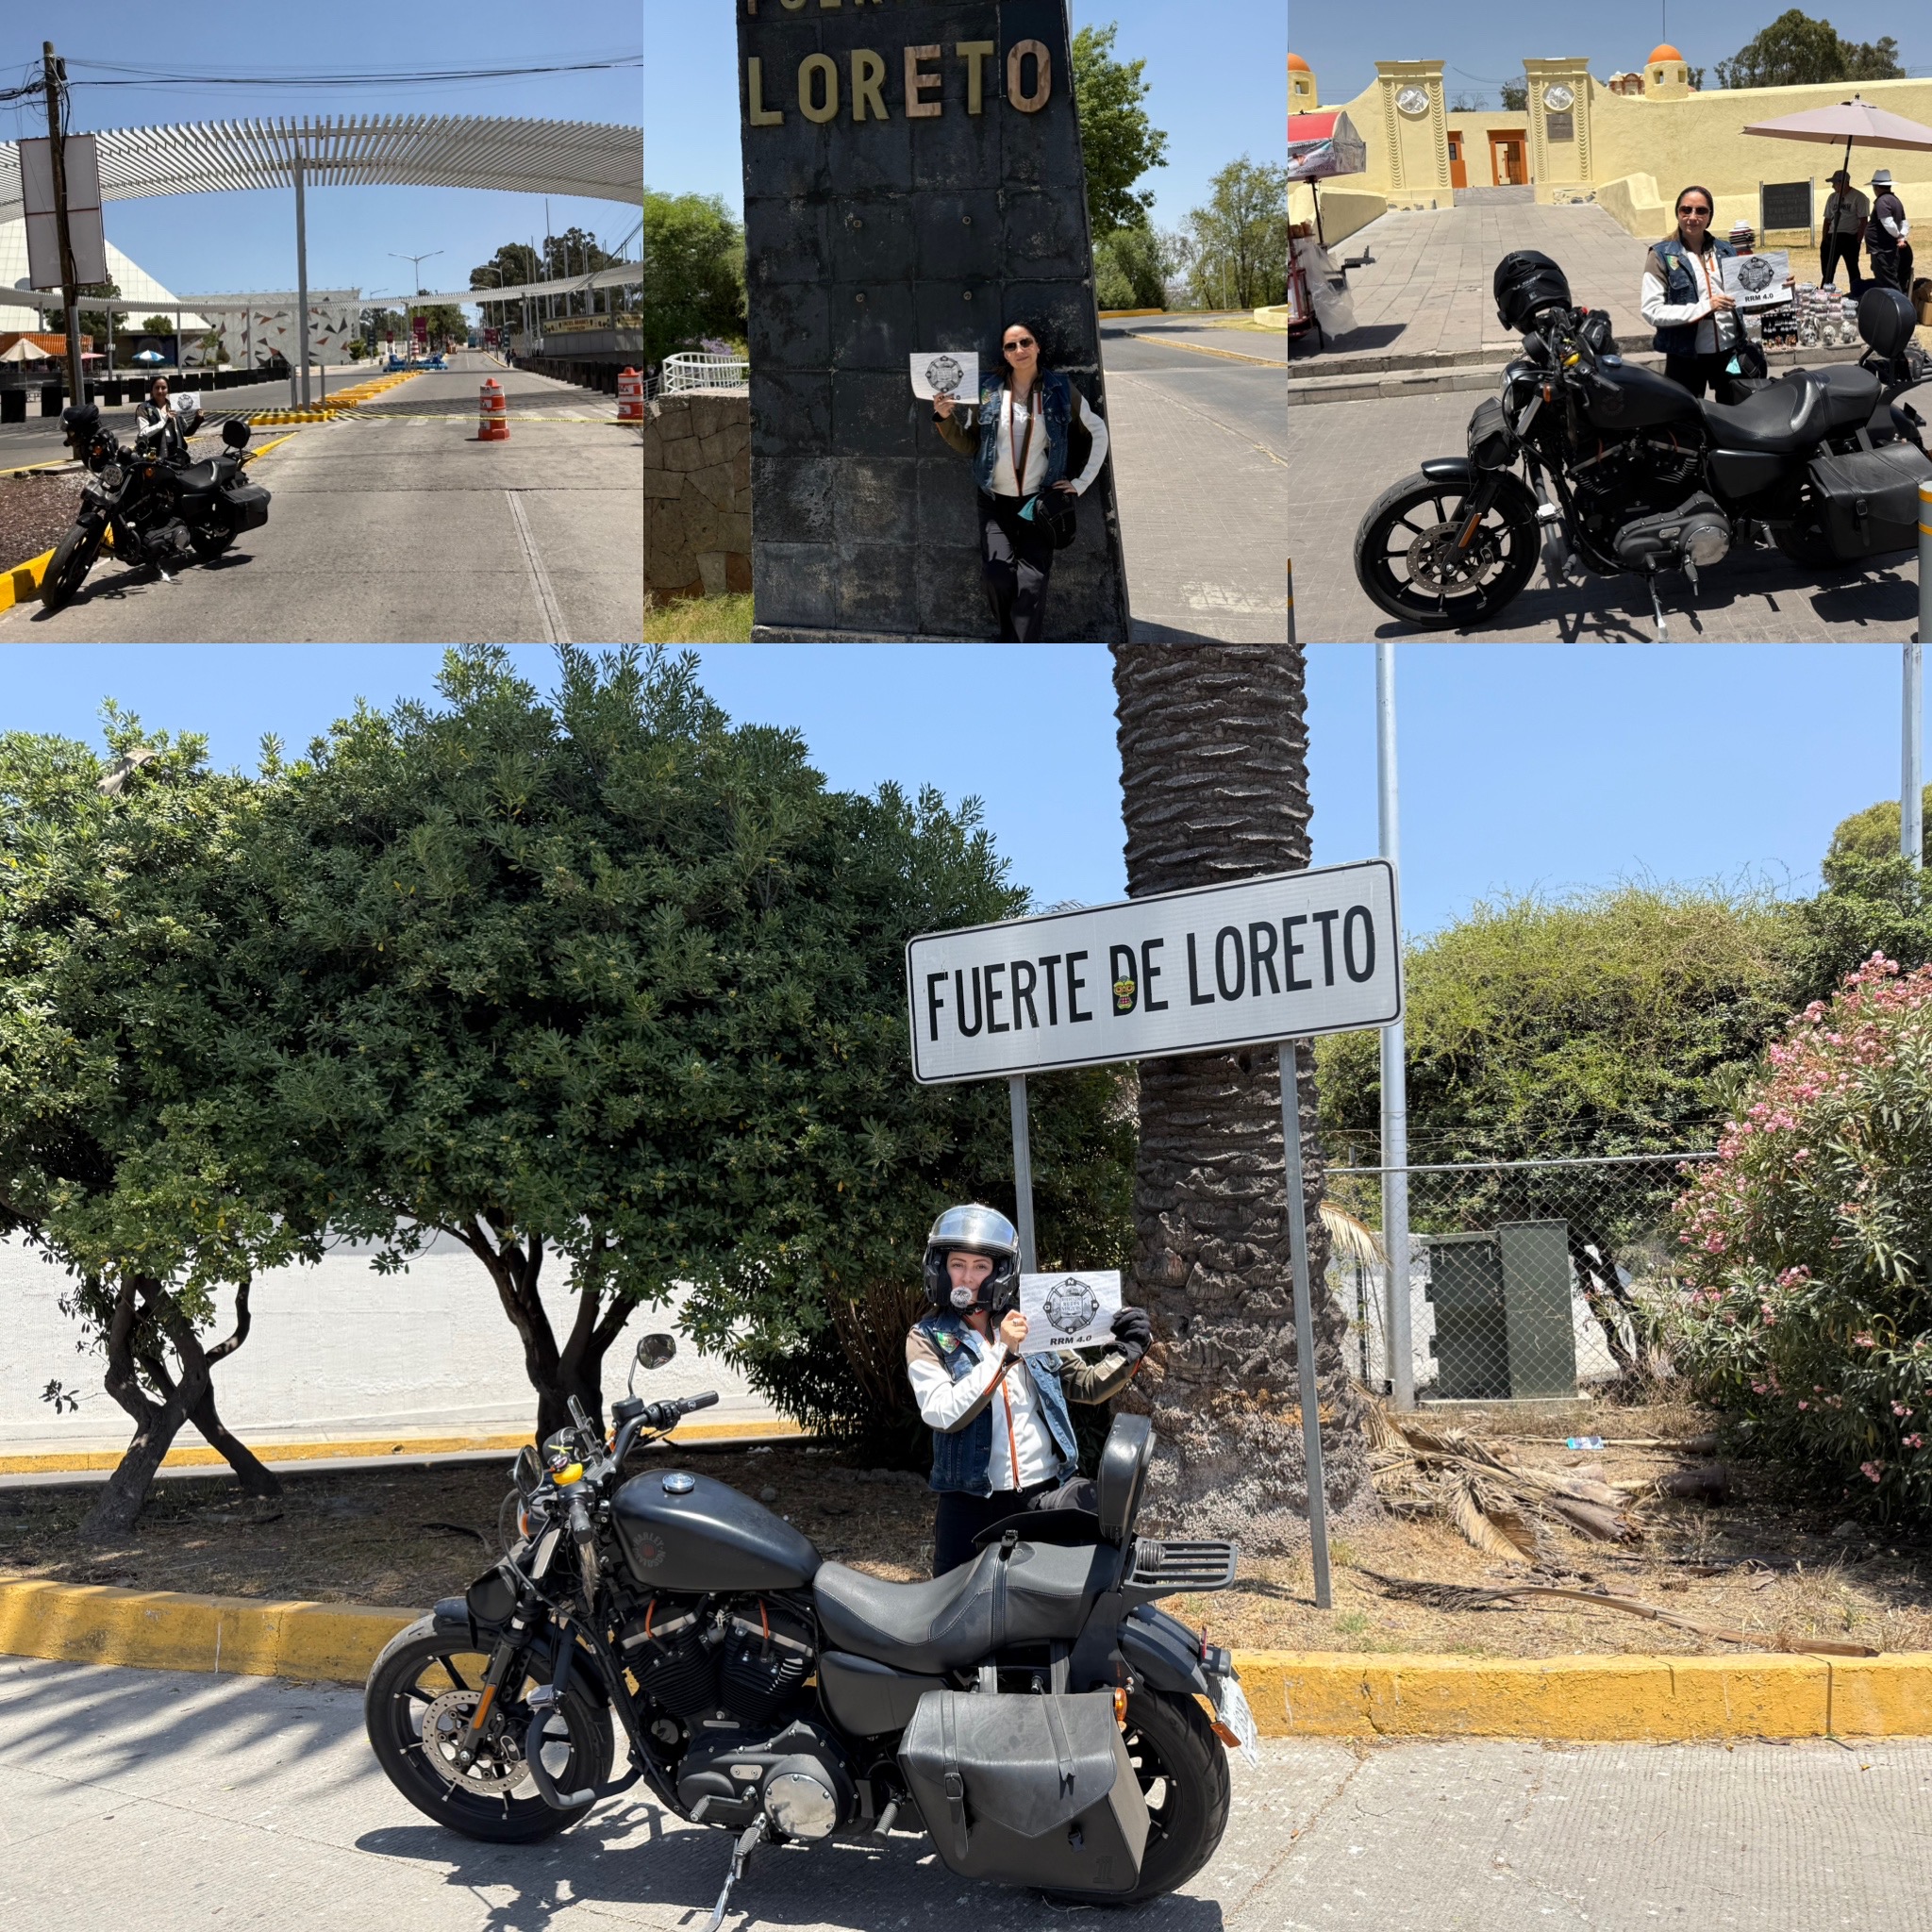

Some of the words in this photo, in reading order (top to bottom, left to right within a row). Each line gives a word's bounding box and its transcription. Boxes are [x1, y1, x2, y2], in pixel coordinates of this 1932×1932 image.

[748, 39, 1051, 125] LORETO
[926, 950, 1092, 1041] FUERTE
[1109, 938, 1169, 1017] DE
[1186, 905, 1375, 1007] LORETO
[1050, 1337, 1074, 1345] RRM
[1076, 1335, 1092, 1343] 4.0
